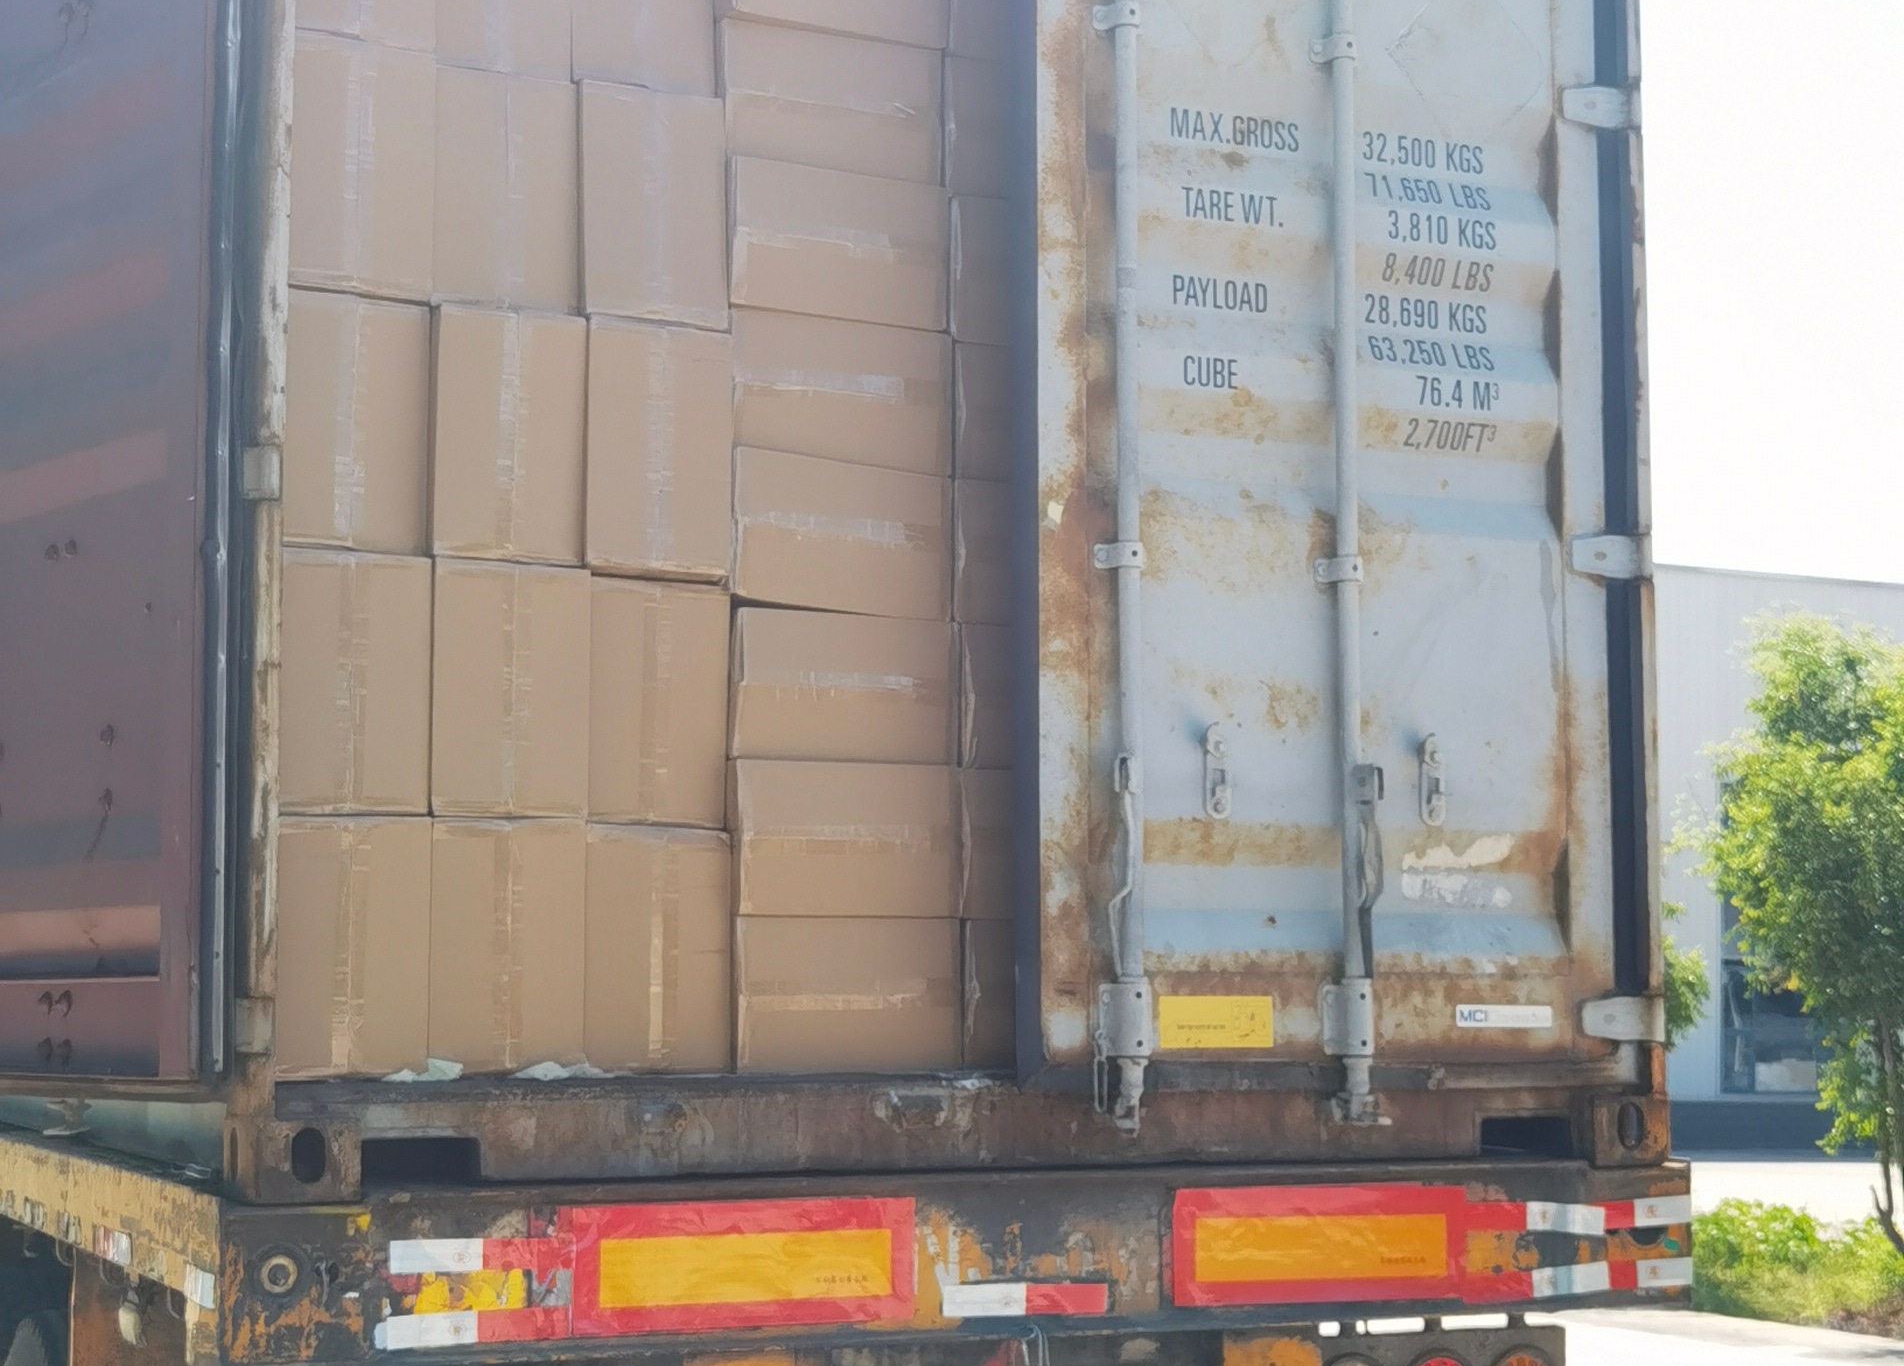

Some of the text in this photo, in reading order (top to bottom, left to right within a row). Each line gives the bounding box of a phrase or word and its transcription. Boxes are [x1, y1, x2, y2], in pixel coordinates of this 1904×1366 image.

[1170, 107, 1484, 175] MAX.GROSS 32,500 KGS
[1364, 172, 1492, 211] 71,650 LBS
[1181, 186, 1497, 250] TARE WT. 3,810 KGS
[1381, 252, 1494, 293] 8,400 LBS
[1172, 275, 1487, 335] PAYLOAD 28,690 KGS
[1368, 336, 1495, 373] 63,250 LBS
[1183, 355, 1239, 390] CUBE
[1415, 376, 1463, 410] 76.4
[1458, 1008, 1489, 1023] MCI
